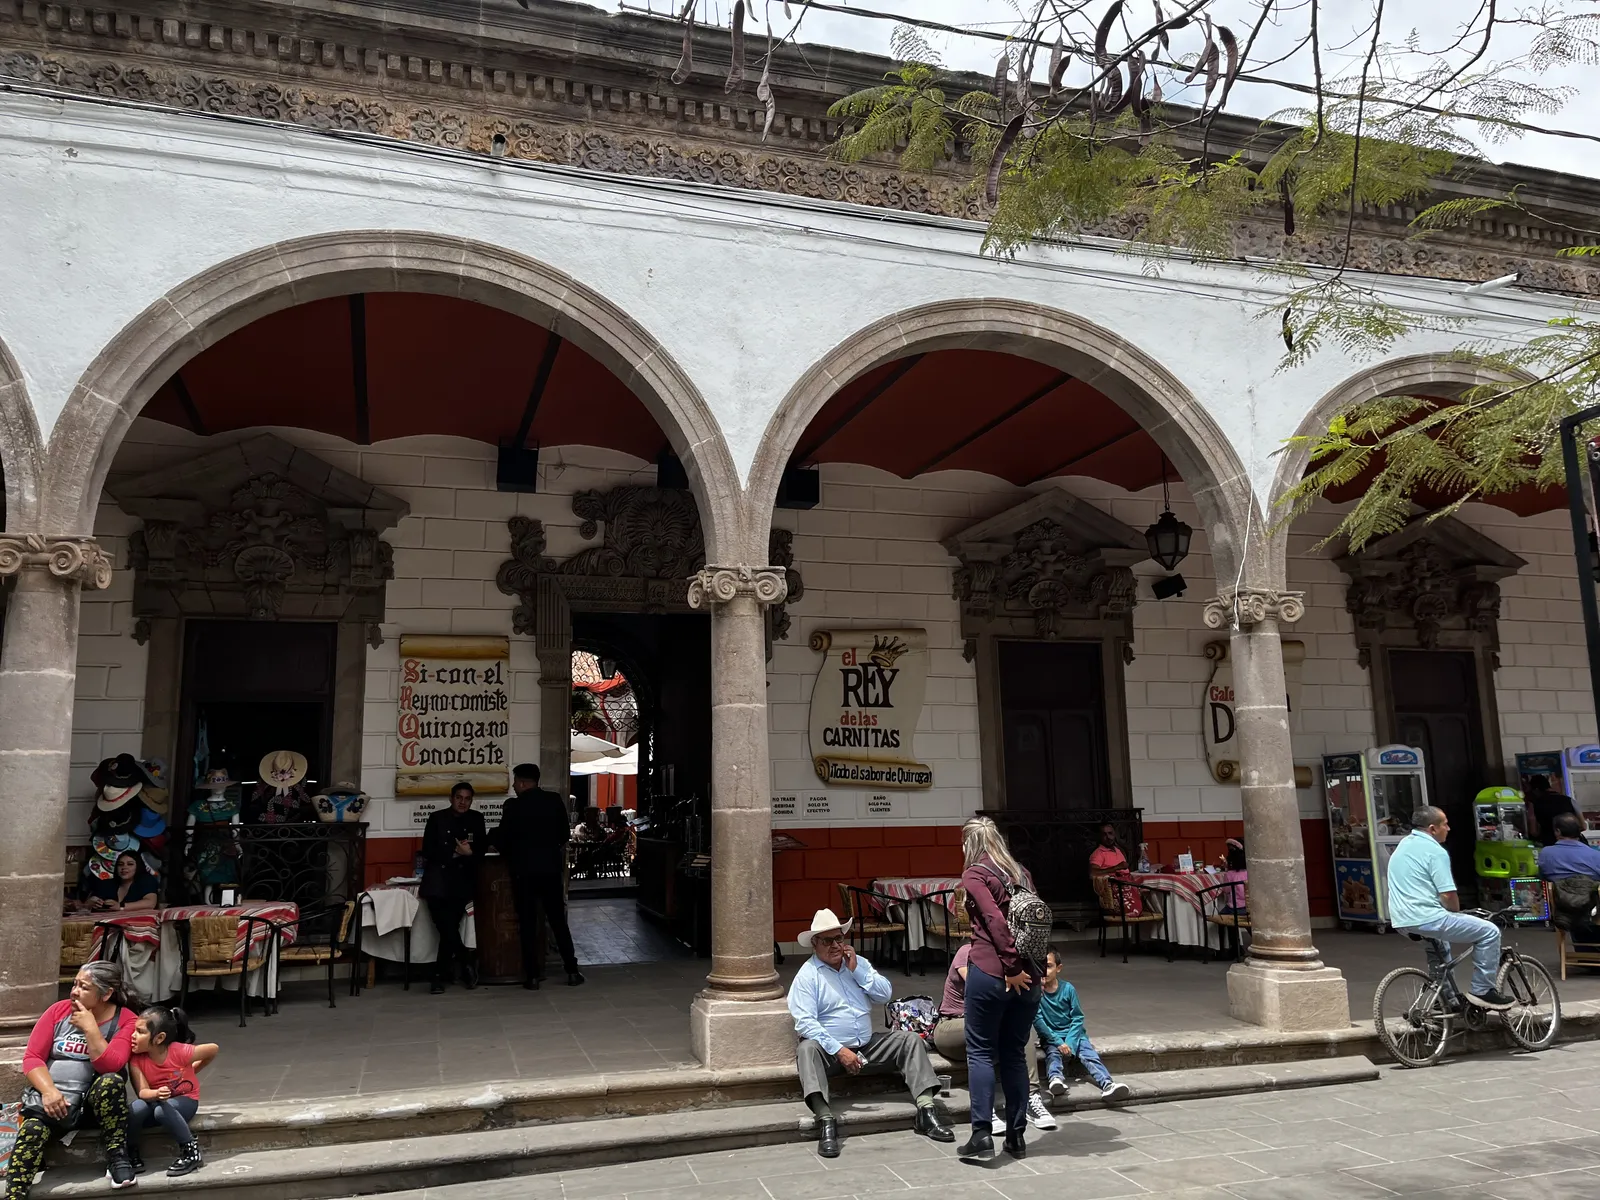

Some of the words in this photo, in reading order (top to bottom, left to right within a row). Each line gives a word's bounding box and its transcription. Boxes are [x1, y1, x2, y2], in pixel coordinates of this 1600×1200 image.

[841, 647, 857, 667] el
[839, 662, 900, 708] REY
[840, 711, 857, 727] de
[857, 711, 878, 727] las
[823, 727, 901, 748] CARNITAS
[401, 740, 505, 766] Conociste
